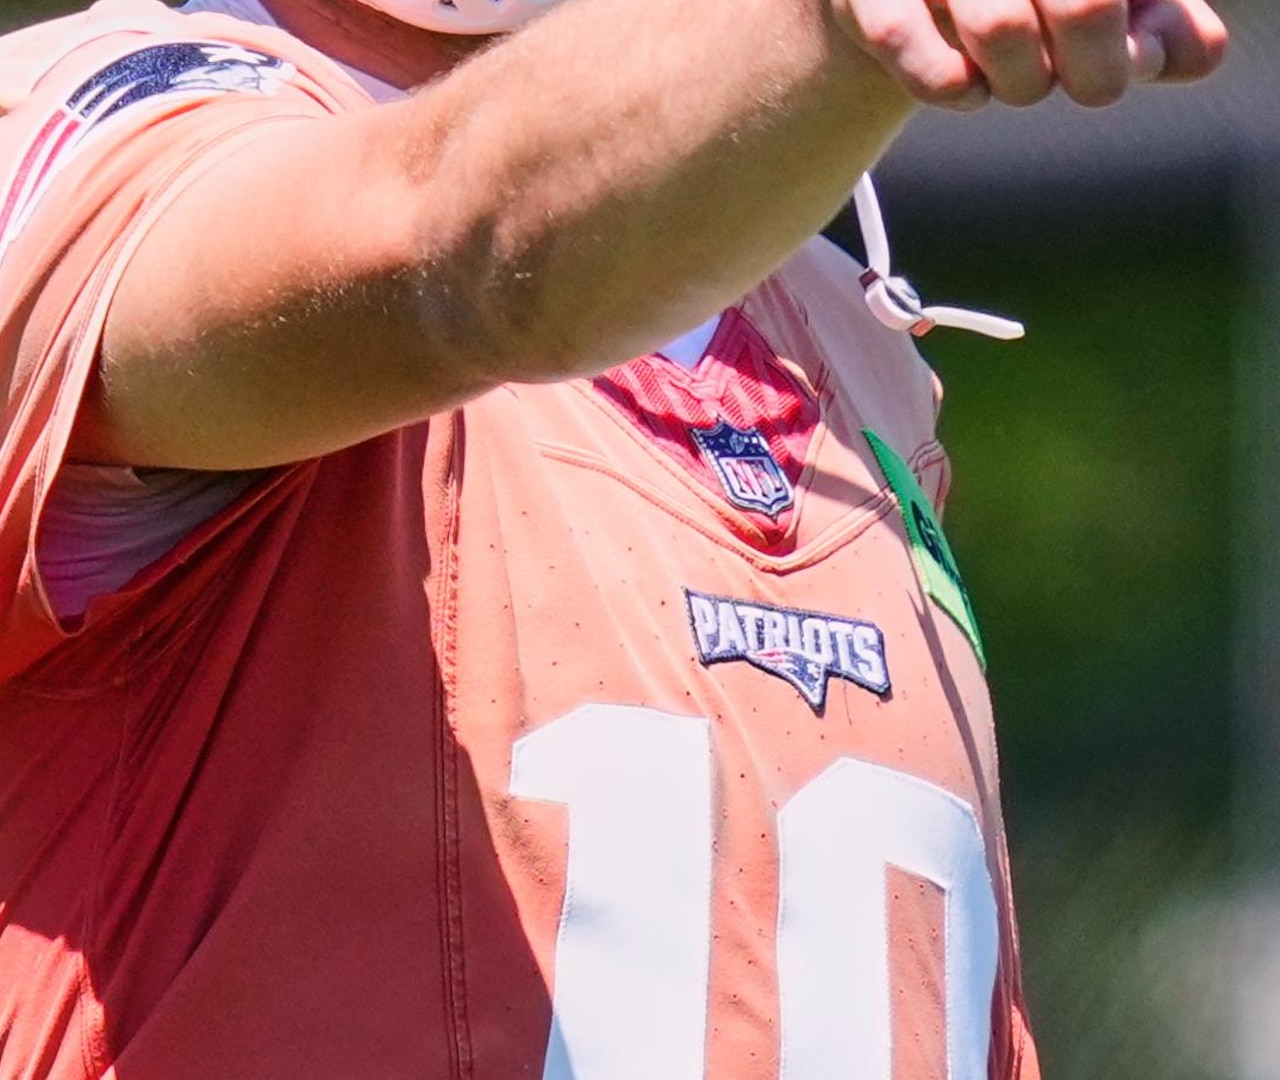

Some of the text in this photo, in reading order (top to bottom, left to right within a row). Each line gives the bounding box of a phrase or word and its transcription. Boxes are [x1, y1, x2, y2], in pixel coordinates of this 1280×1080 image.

[723, 459, 783, 499] NFL
[689, 594, 888, 686] PATRIOTS
[510, 702, 998, 1080] 10
